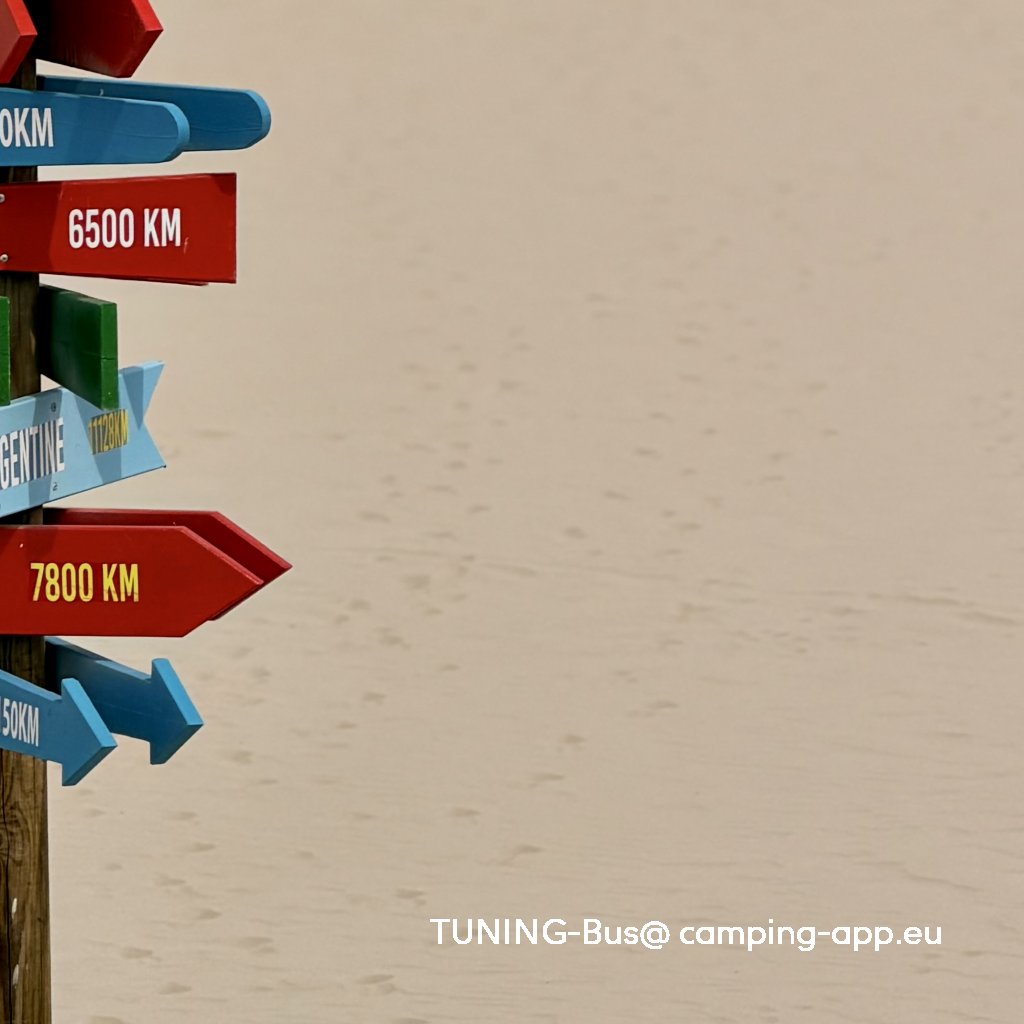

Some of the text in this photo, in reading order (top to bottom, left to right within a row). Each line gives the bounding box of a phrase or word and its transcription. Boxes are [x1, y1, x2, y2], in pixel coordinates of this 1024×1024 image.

[68, 208, 135, 249] 6500
[143, 208, 182, 248] KM
[30, 562, 94, 602] 7800
[102, 563, 139, 602] KM
